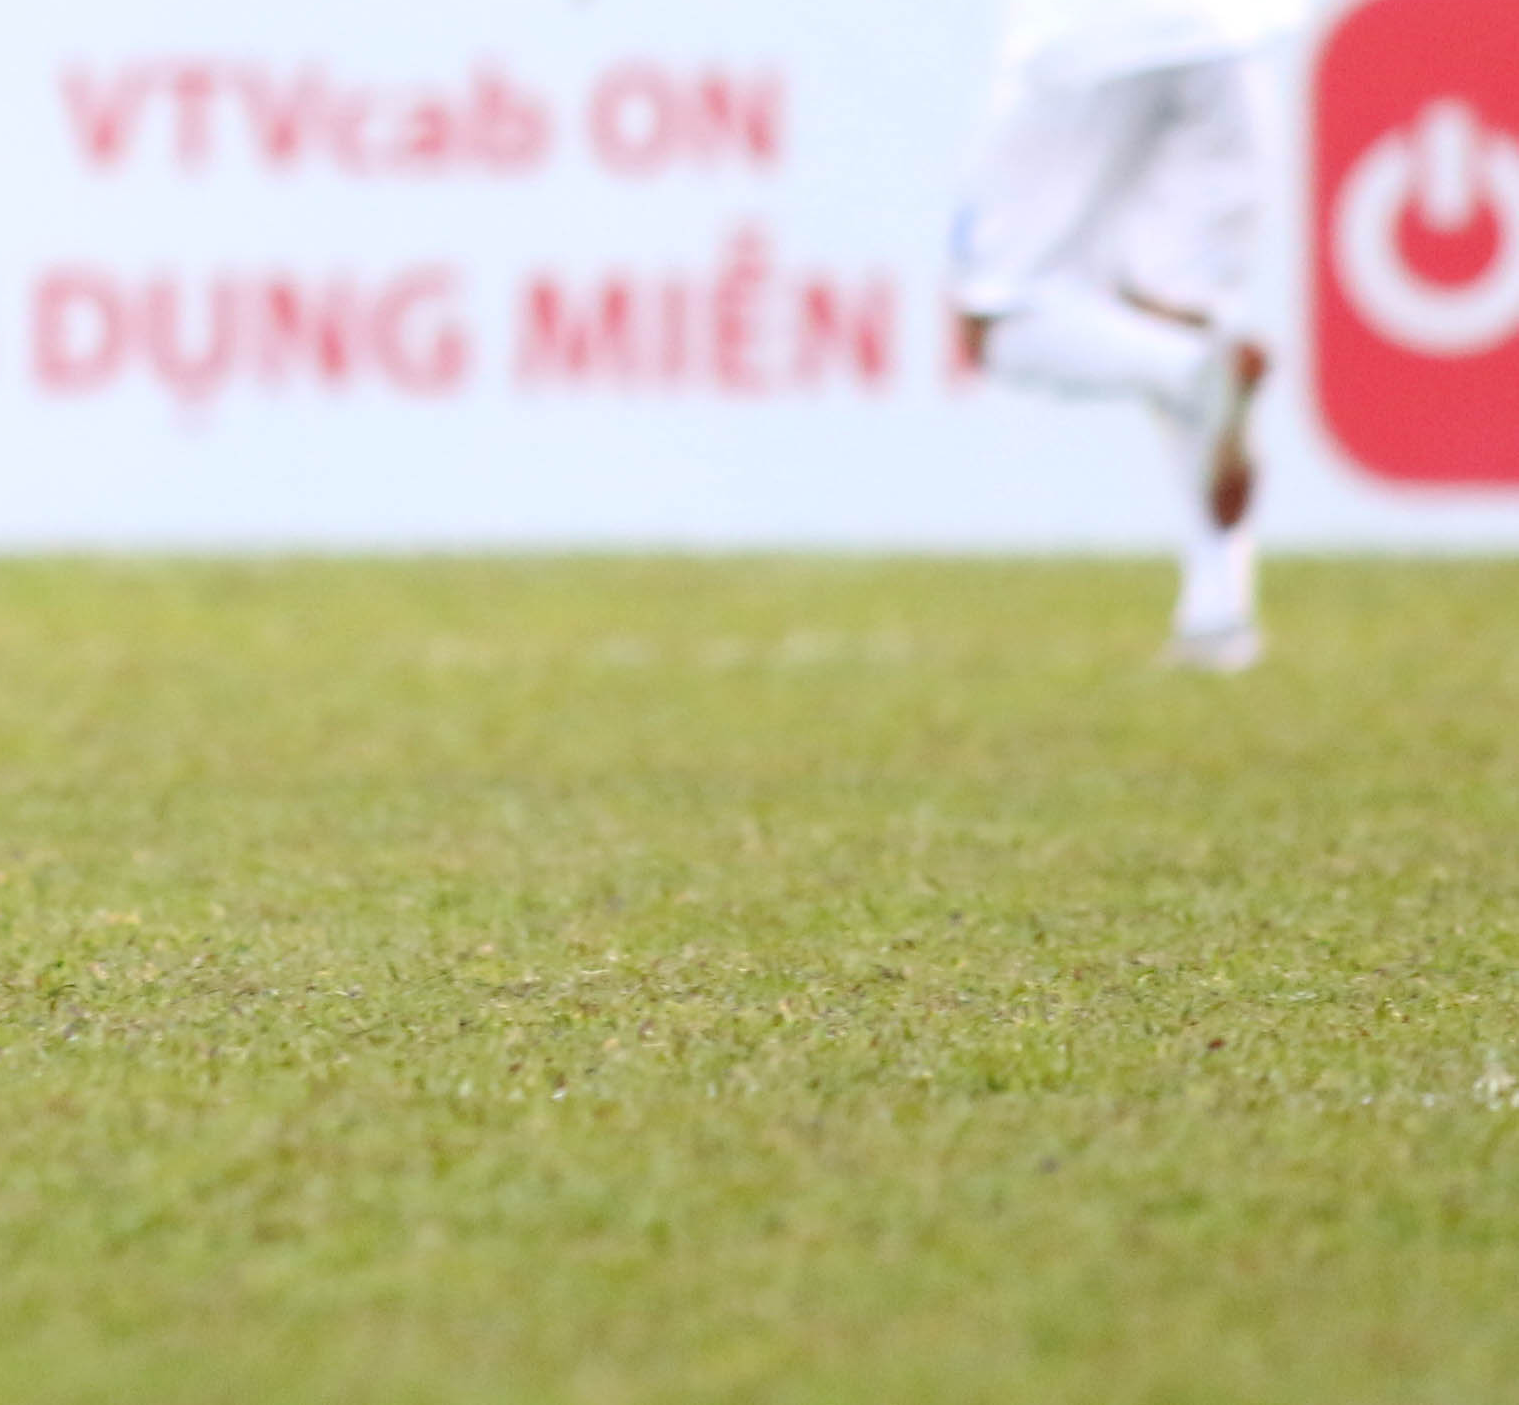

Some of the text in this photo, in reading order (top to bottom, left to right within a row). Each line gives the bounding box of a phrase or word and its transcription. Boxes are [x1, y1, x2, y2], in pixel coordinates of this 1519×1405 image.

[57, 57, 786, 175] VTVcab ON
[28, 263, 470, 435] DỤNG
